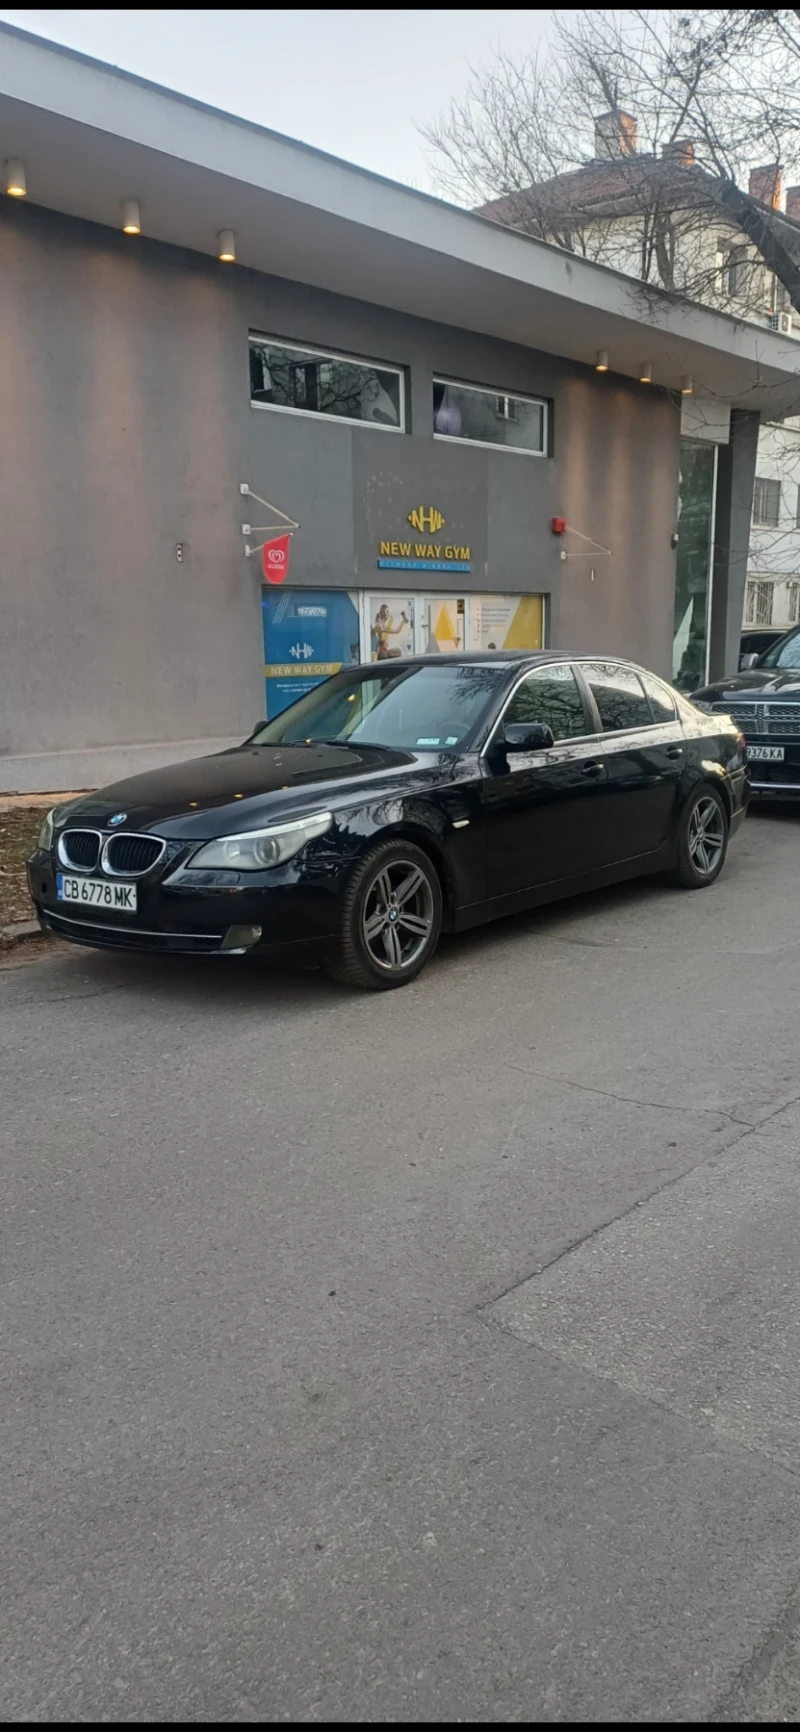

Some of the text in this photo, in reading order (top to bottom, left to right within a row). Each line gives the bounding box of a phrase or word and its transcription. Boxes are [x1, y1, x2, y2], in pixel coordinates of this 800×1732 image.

[380, 541, 470, 560] NEW WAY GYM
[271, 664, 333, 675] NEW WAY GYM
[770, 748, 783, 759] KA
[64, 879, 79, 900] CB
[81, 882, 112, 905] 6778
[115, 886, 133, 908] MK
